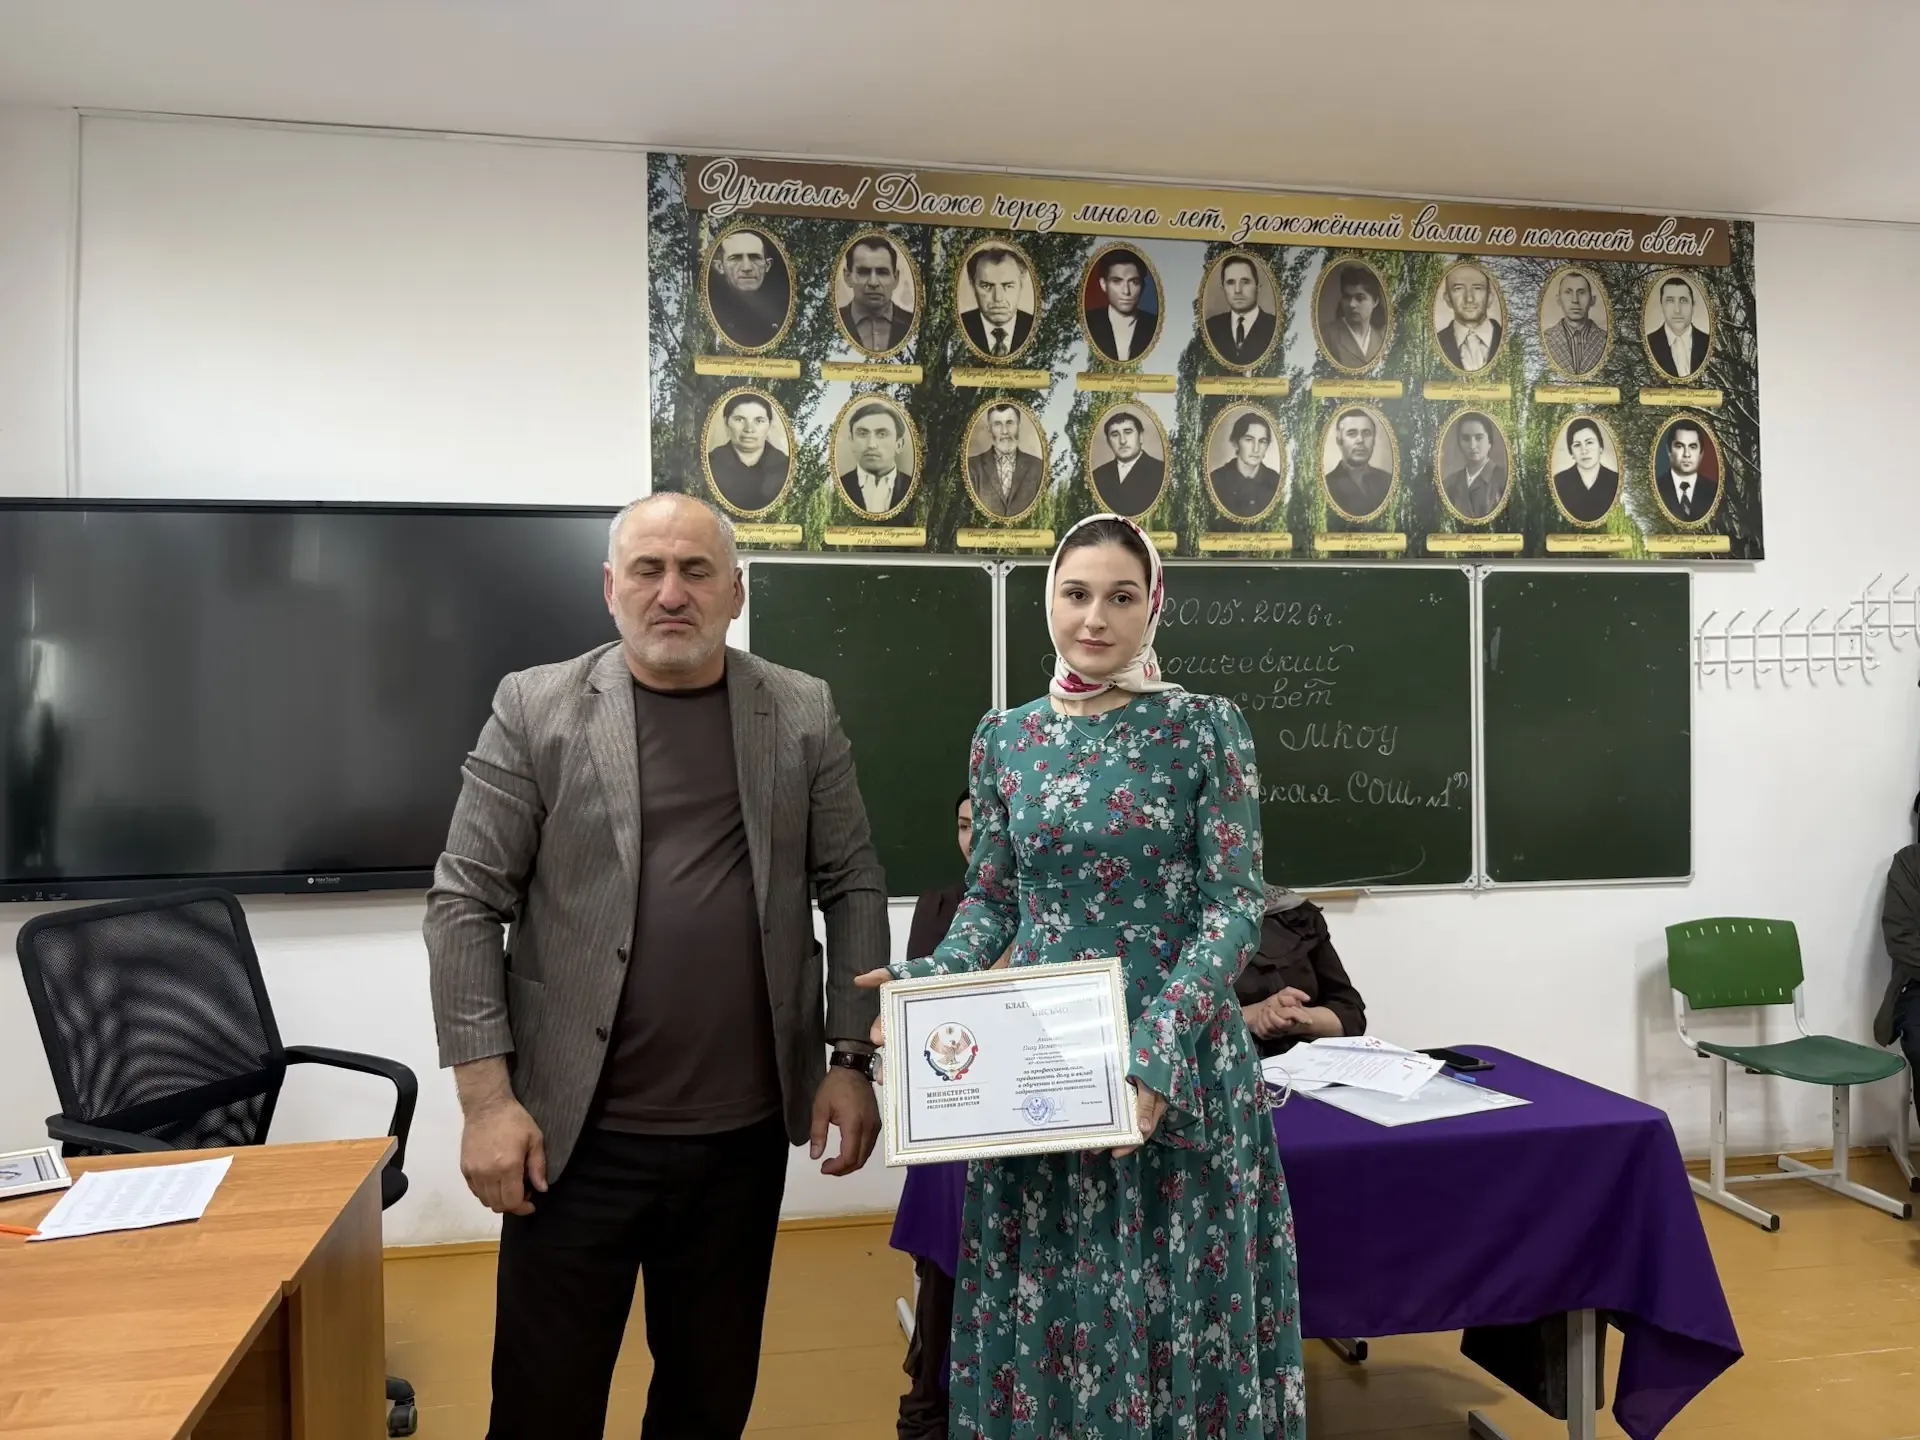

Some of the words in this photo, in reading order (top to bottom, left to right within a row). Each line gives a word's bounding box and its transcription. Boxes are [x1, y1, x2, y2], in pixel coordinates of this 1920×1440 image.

[699, 158, 872, 217] Учитель!
[874, 171, 983, 216] Даже
[991, 198, 1063, 233] через
[1072, 204, 1160, 227] много
[1168, 205, 1228, 233] лет,
[1231, 208, 1403, 244] зажжённый
[1408, 204, 1480, 244] вами
[1486, 227, 1516, 246] не
[1522, 227, 1634, 252] погаснет
[1640, 217, 1715, 256] свет!
[1158, 644, 1355, 676] огический
[1232, 677, 1337, 711] совет
[926, 1088, 980, 1098] МИНИСТЕРСТВО
